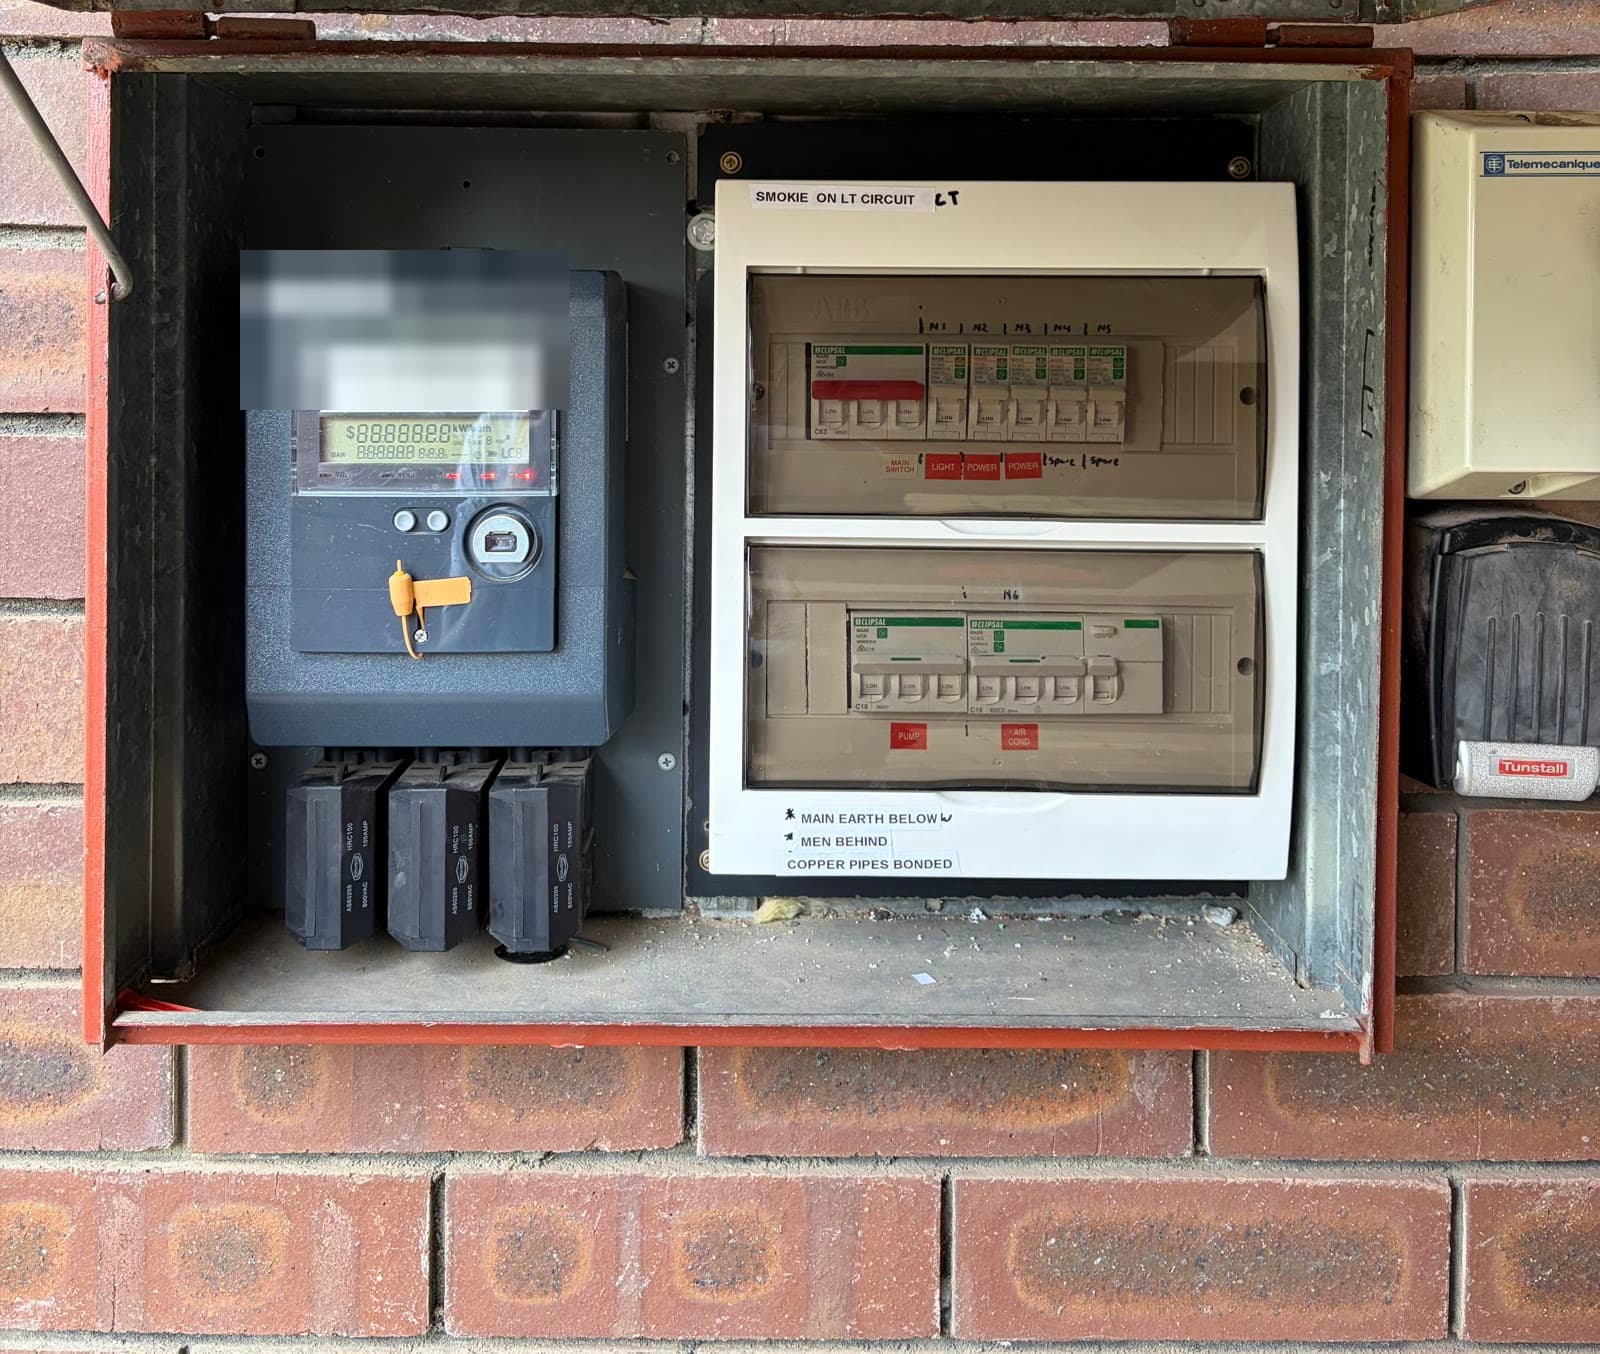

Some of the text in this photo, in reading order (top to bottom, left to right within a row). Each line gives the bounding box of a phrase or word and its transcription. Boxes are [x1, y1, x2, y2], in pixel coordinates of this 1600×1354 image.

[1506, 160, 1600, 170] Telemecanique
[756, 191, 916, 205] SMOKIE ON LT CIRCUIT
[932, 463, 955, 471] LIGHT
[967, 464, 998, 472] POWER
[1008, 462, 1039, 470] POWER
[898, 732, 920, 740] PUMP
[1008, 738, 1030, 746] COND
[1501, 762, 1564, 774] Tunstall
[801, 814, 938, 824] MAIN EARTH BELOW
[801, 836, 888, 847] MEN BEHIND
[787, 859, 952, 870] COPPER PIPES BONDED
